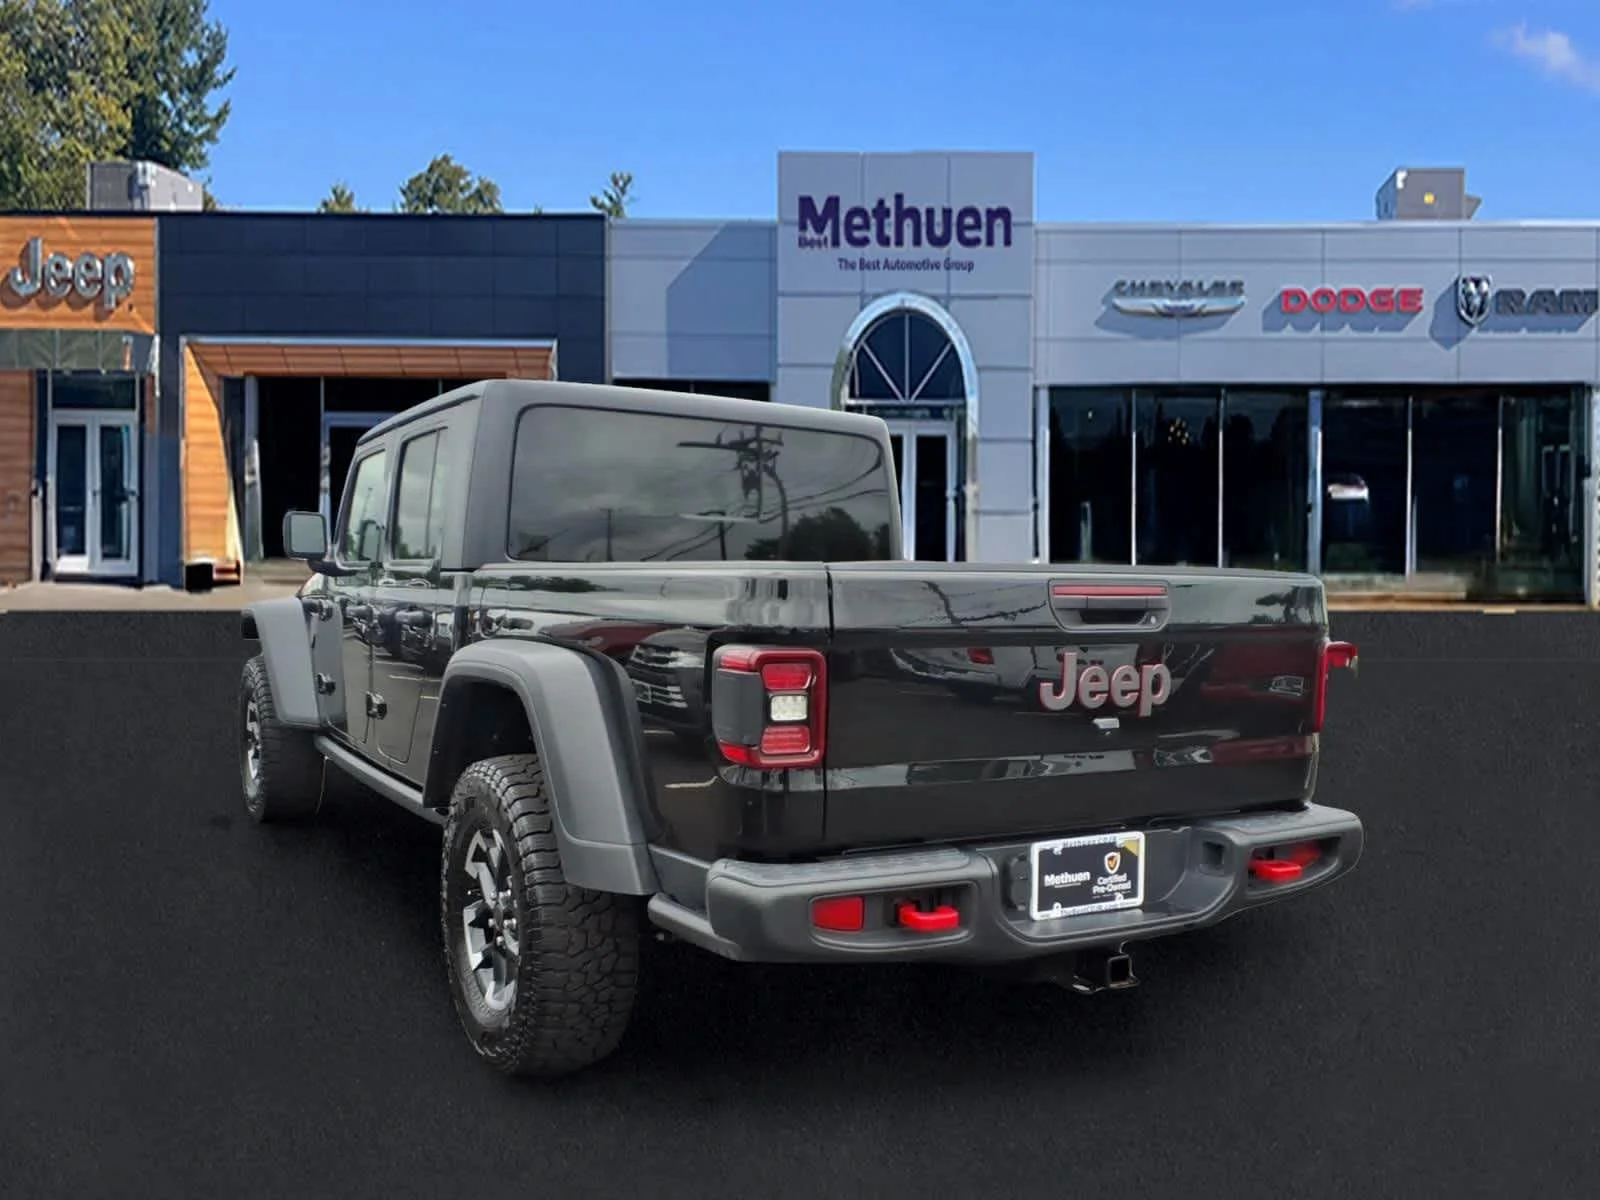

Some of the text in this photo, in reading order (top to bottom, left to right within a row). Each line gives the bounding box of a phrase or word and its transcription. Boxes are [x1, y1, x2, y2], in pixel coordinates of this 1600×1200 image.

[798, 193, 1012, 248] Methuen
[10, 237, 135, 309] Jeep
[838, 256, 974, 273] The Best Automotive Group
[1114, 279, 1245, 297] CHRYSLER
[1281, 287, 1424, 313] DODGE
[1495, 288, 1598, 315] RAM
[1039, 651, 1172, 718] Jeep
[1044, 871, 1091, 887] Methuen
